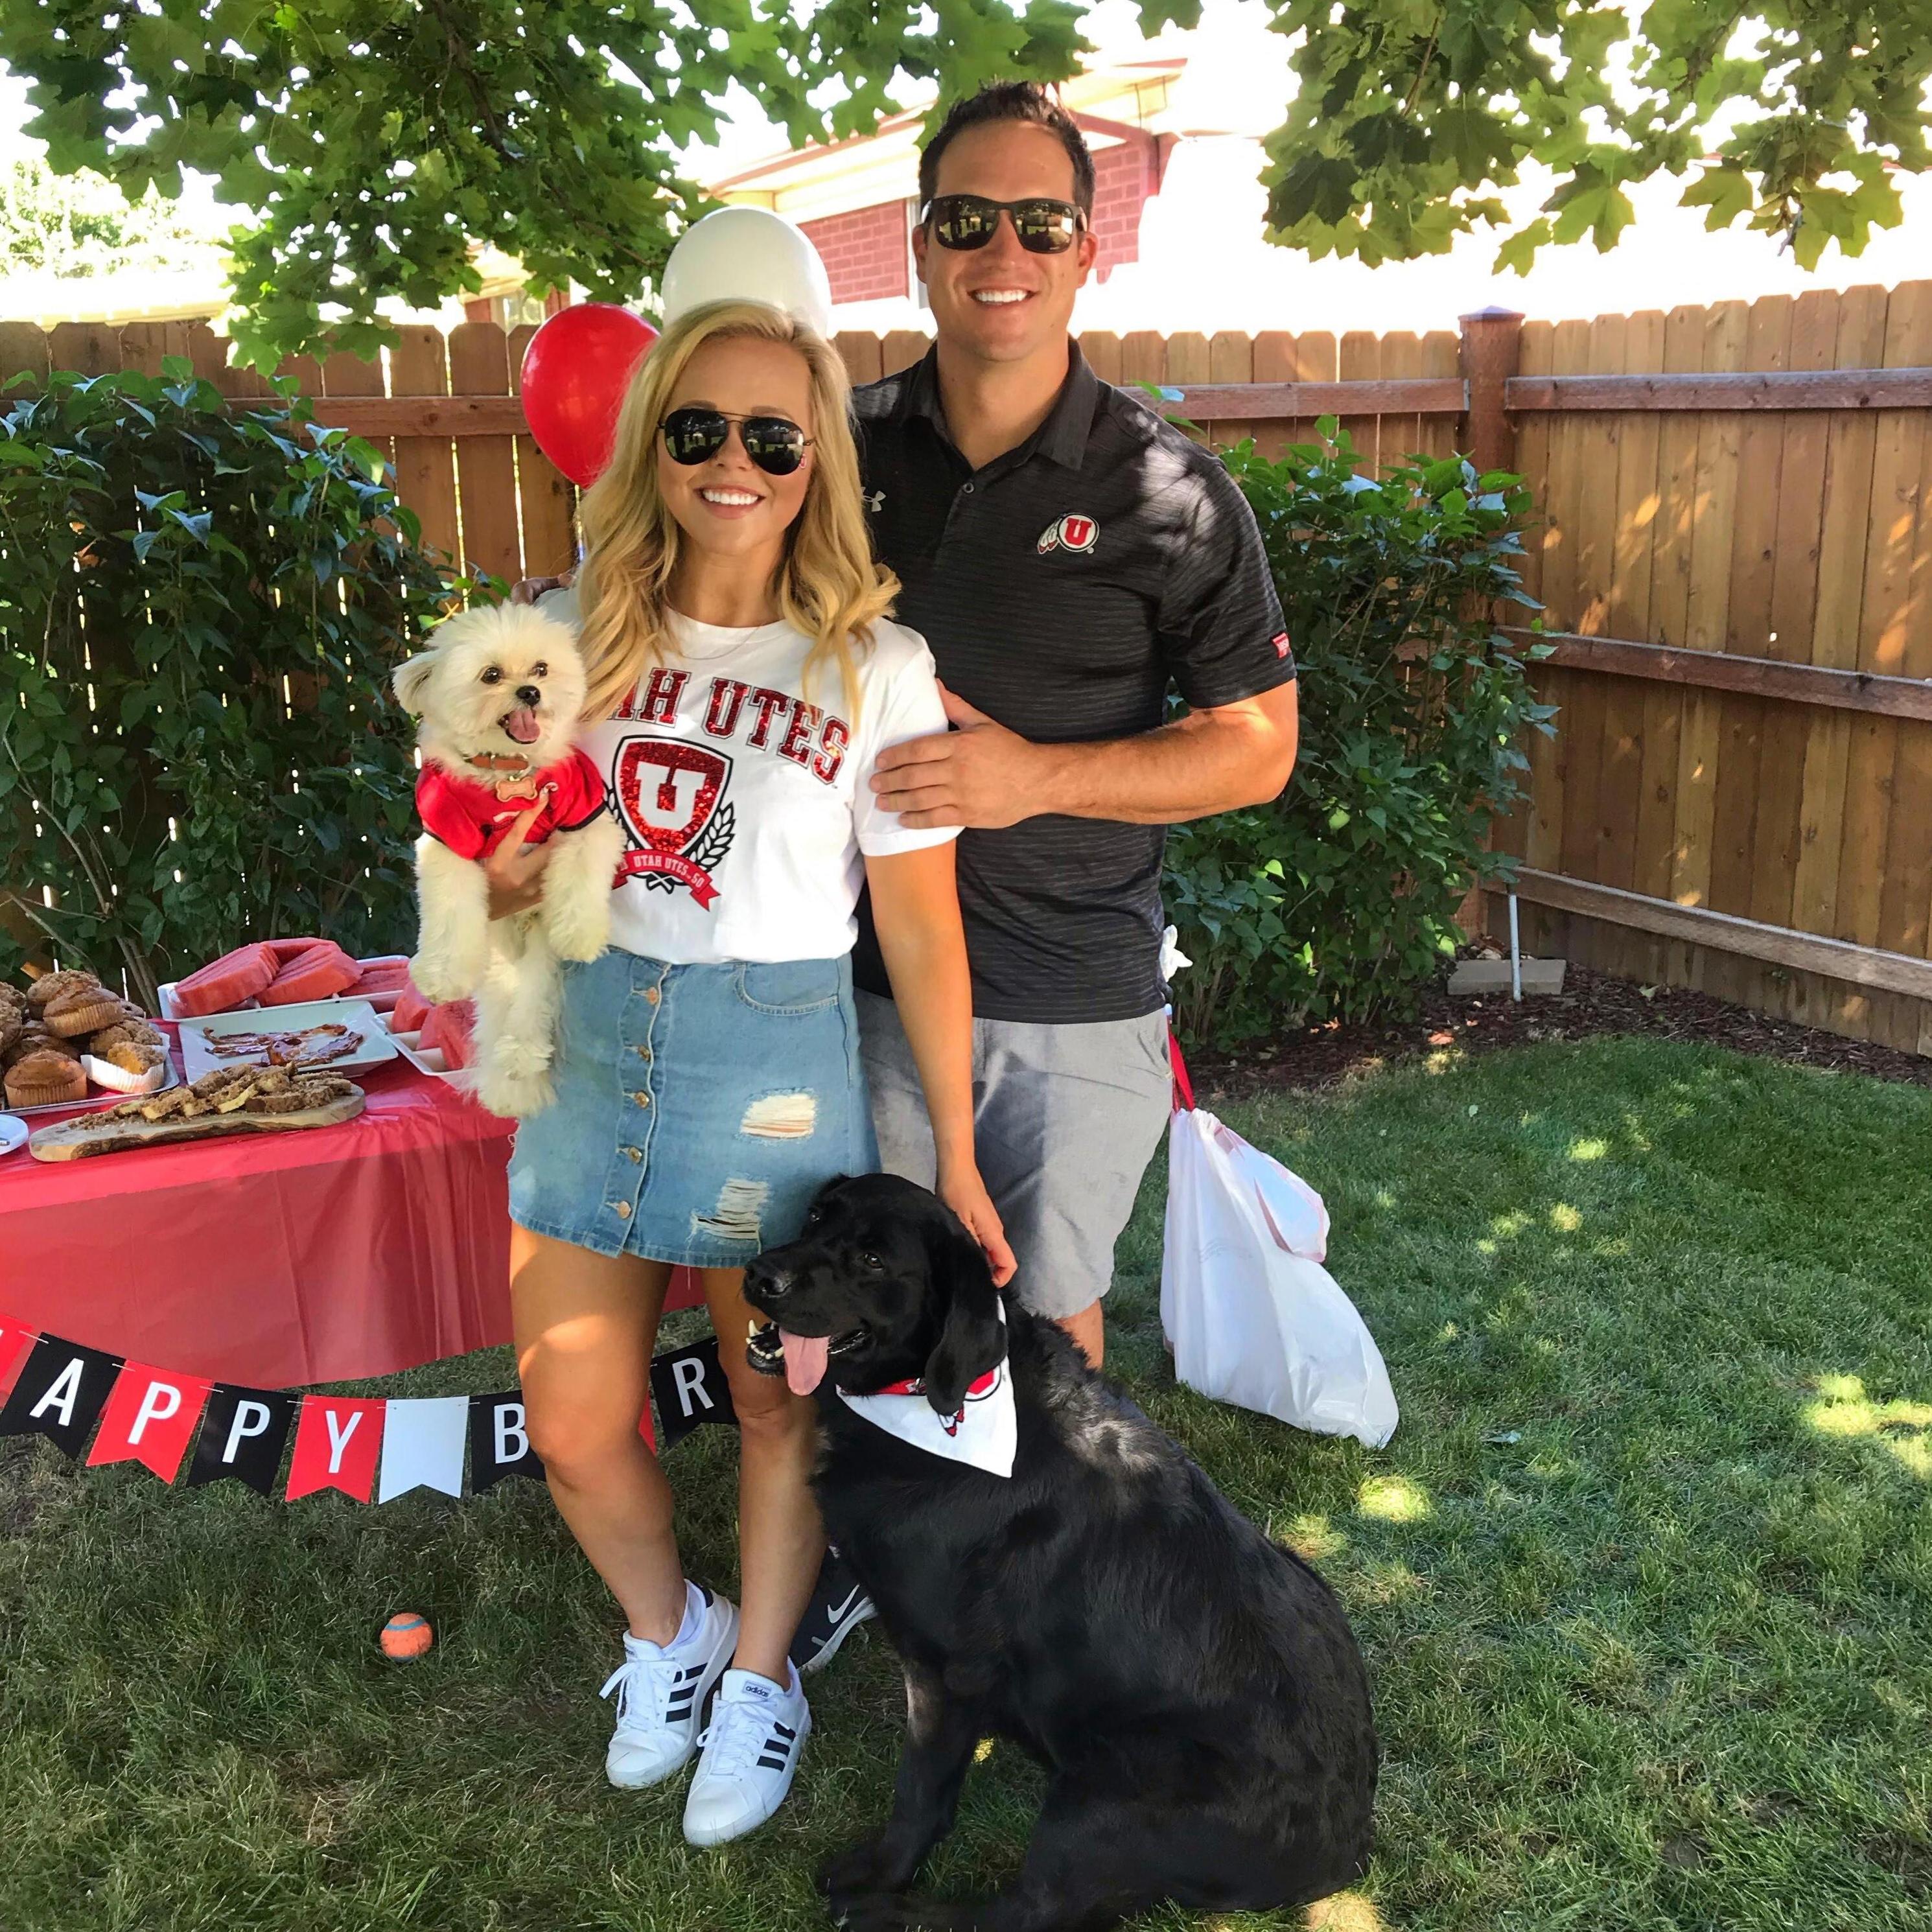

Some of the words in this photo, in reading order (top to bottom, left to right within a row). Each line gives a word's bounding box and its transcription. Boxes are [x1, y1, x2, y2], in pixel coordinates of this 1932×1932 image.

[1064, 517, 1093, 546] U
[701, 677, 850, 785] UTES
[634, 761, 707, 830] U
[633, 854, 662, 867] UTAH
[664, 857, 689, 876] UTES
[0, 1330, 363, 1474] APPY
[745, 1686, 769, 1697] adidas
